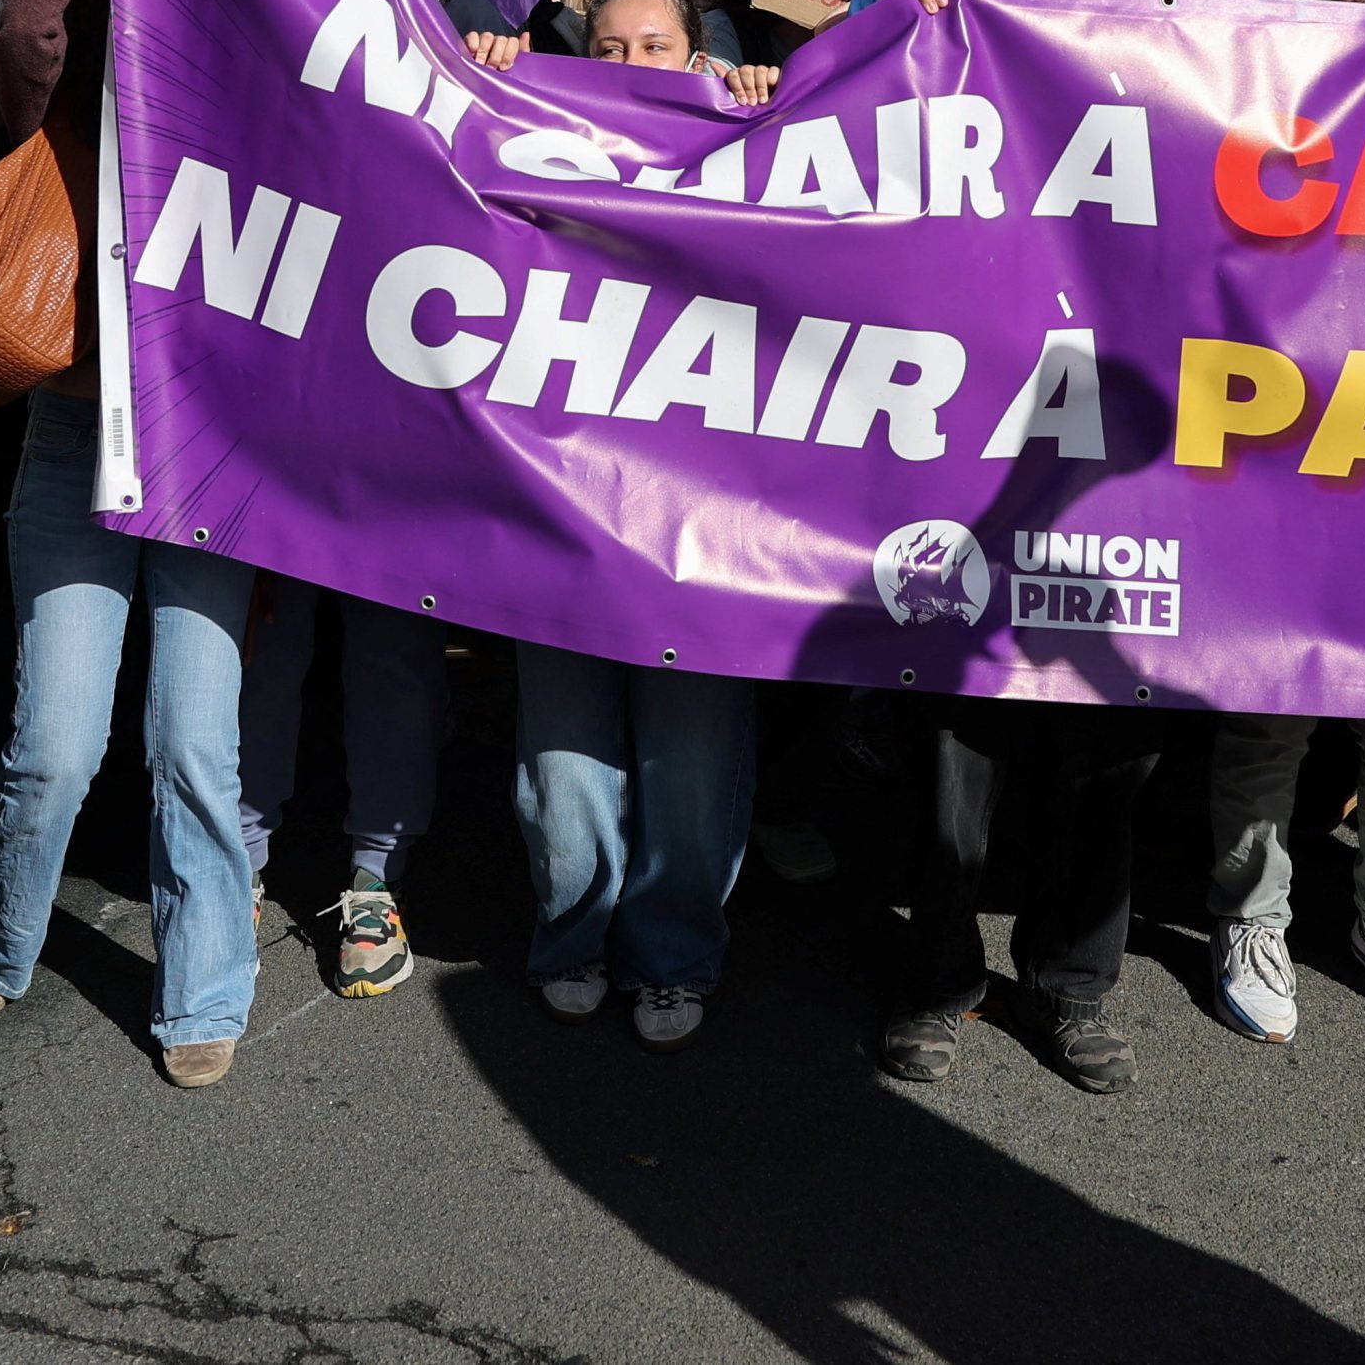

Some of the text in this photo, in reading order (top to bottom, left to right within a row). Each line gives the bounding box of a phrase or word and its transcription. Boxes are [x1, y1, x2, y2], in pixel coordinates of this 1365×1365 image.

[1031, 71, 1157, 226] À
[133, 156, 342, 339] NI
[366, 245, 968, 462] CHAIR
[980, 291, 1107, 460] À
[1015, 530, 1180, 580] UNION
[1019, 582, 1172, 627] PIRATE
